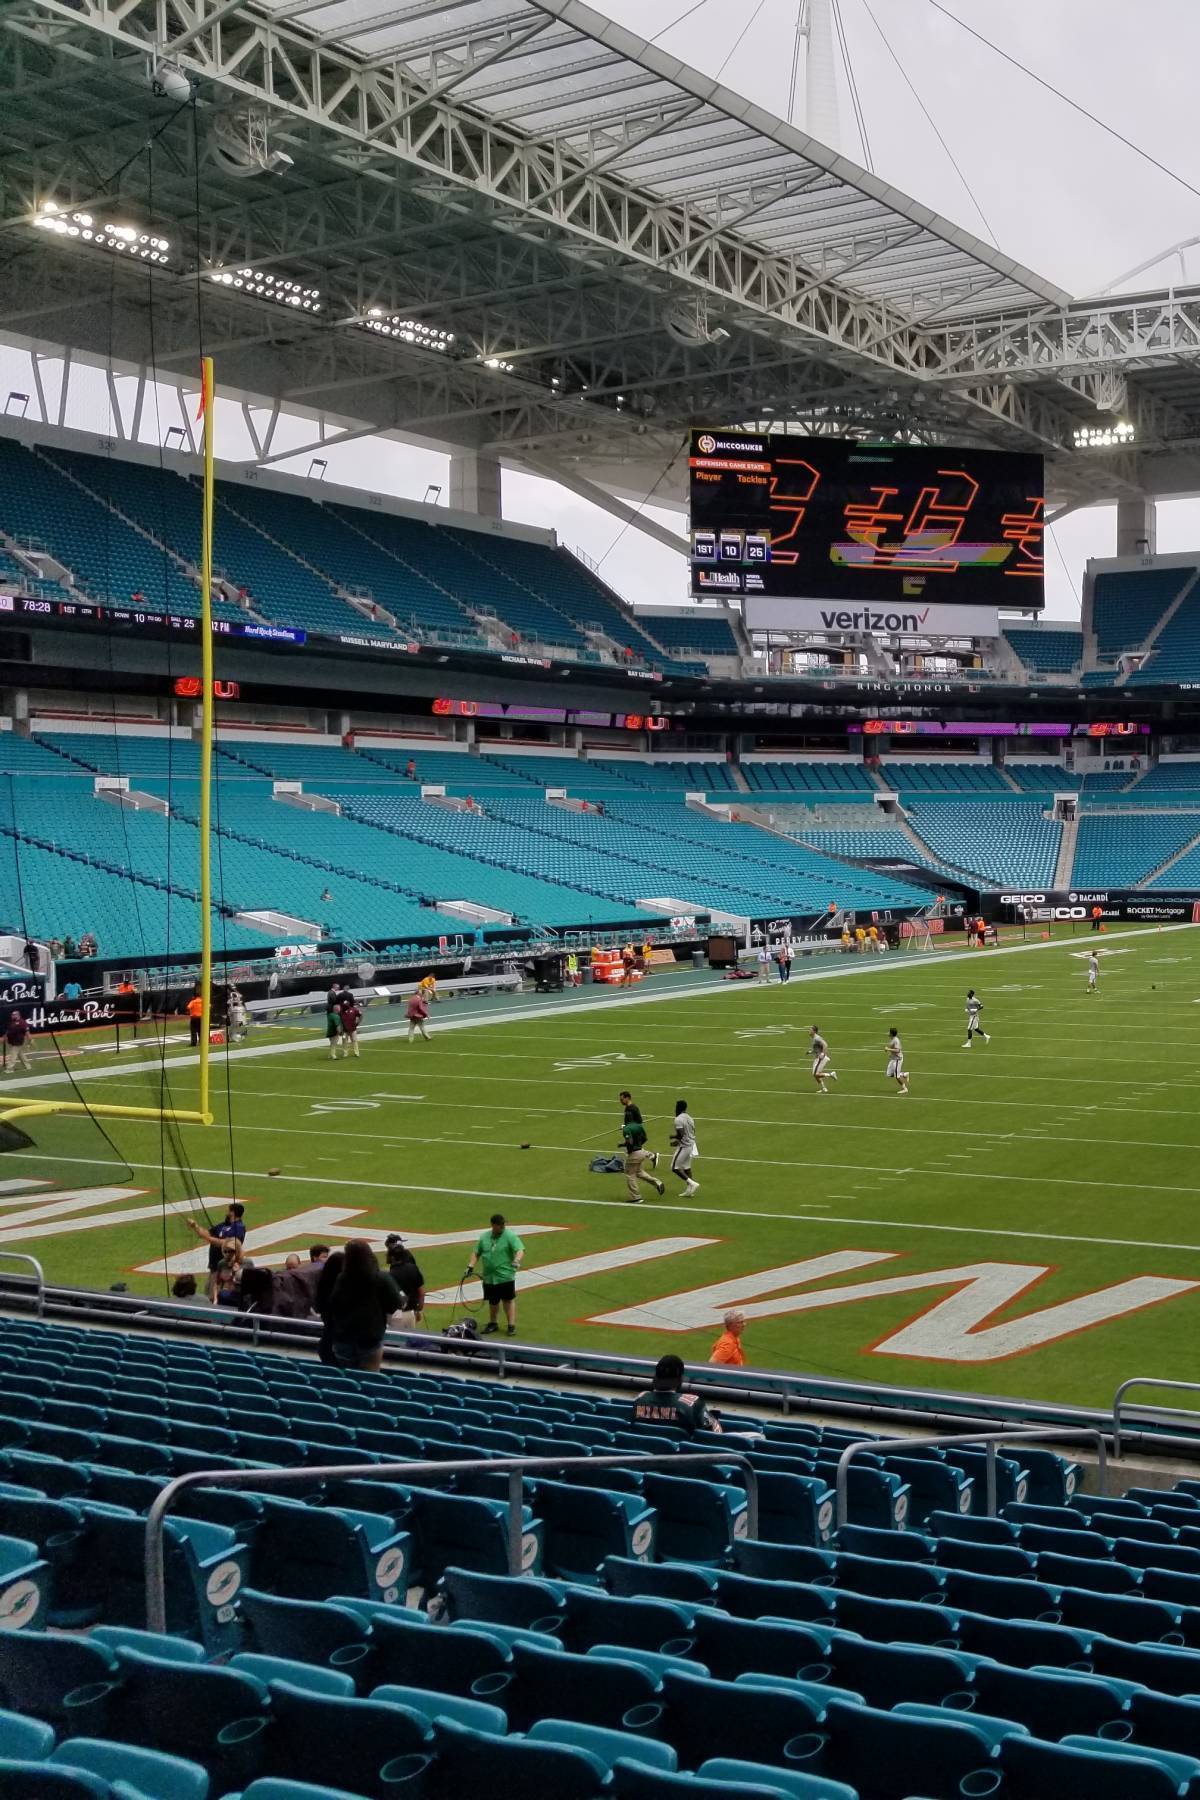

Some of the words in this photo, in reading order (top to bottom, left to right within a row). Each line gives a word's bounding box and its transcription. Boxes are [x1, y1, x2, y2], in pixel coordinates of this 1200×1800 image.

[716, 441, 763, 452] MICCOSUKEE
[696, 471, 722, 482] Player
[737, 474, 768, 485] Tackles
[697, 545, 713, 554] 1ST
[725, 546, 737, 556] 10
[22, 600, 51, 613] 78:28
[63, 606, 76, 614] 1ST
[134, 613, 145, 623] 10
[184, 618, 195, 628] 25
[820, 607, 918, 632] verizon
[220, 621, 230, 632] PM
[340, 635, 370, 647] RUSSELL
[370, 639, 408, 651] MARYLAND
[501, 655, 528, 664] MICHAEL
[857, 682, 892, 691] RING
[903, 683, 951, 692] HONOR
[1000, 895, 1046, 904] GEICO
[1079, 892, 1109, 902] BACARDÍ
[1023, 906, 1087, 919] GEICO
[11, 982, 40, 998] Park
[26, 1007, 87, 1028] Hialeah
[83, 1001, 114, 1020] Park
[311, 1092, 428, 1111] 10
[636, 1405, 677, 1420] MIAMI
